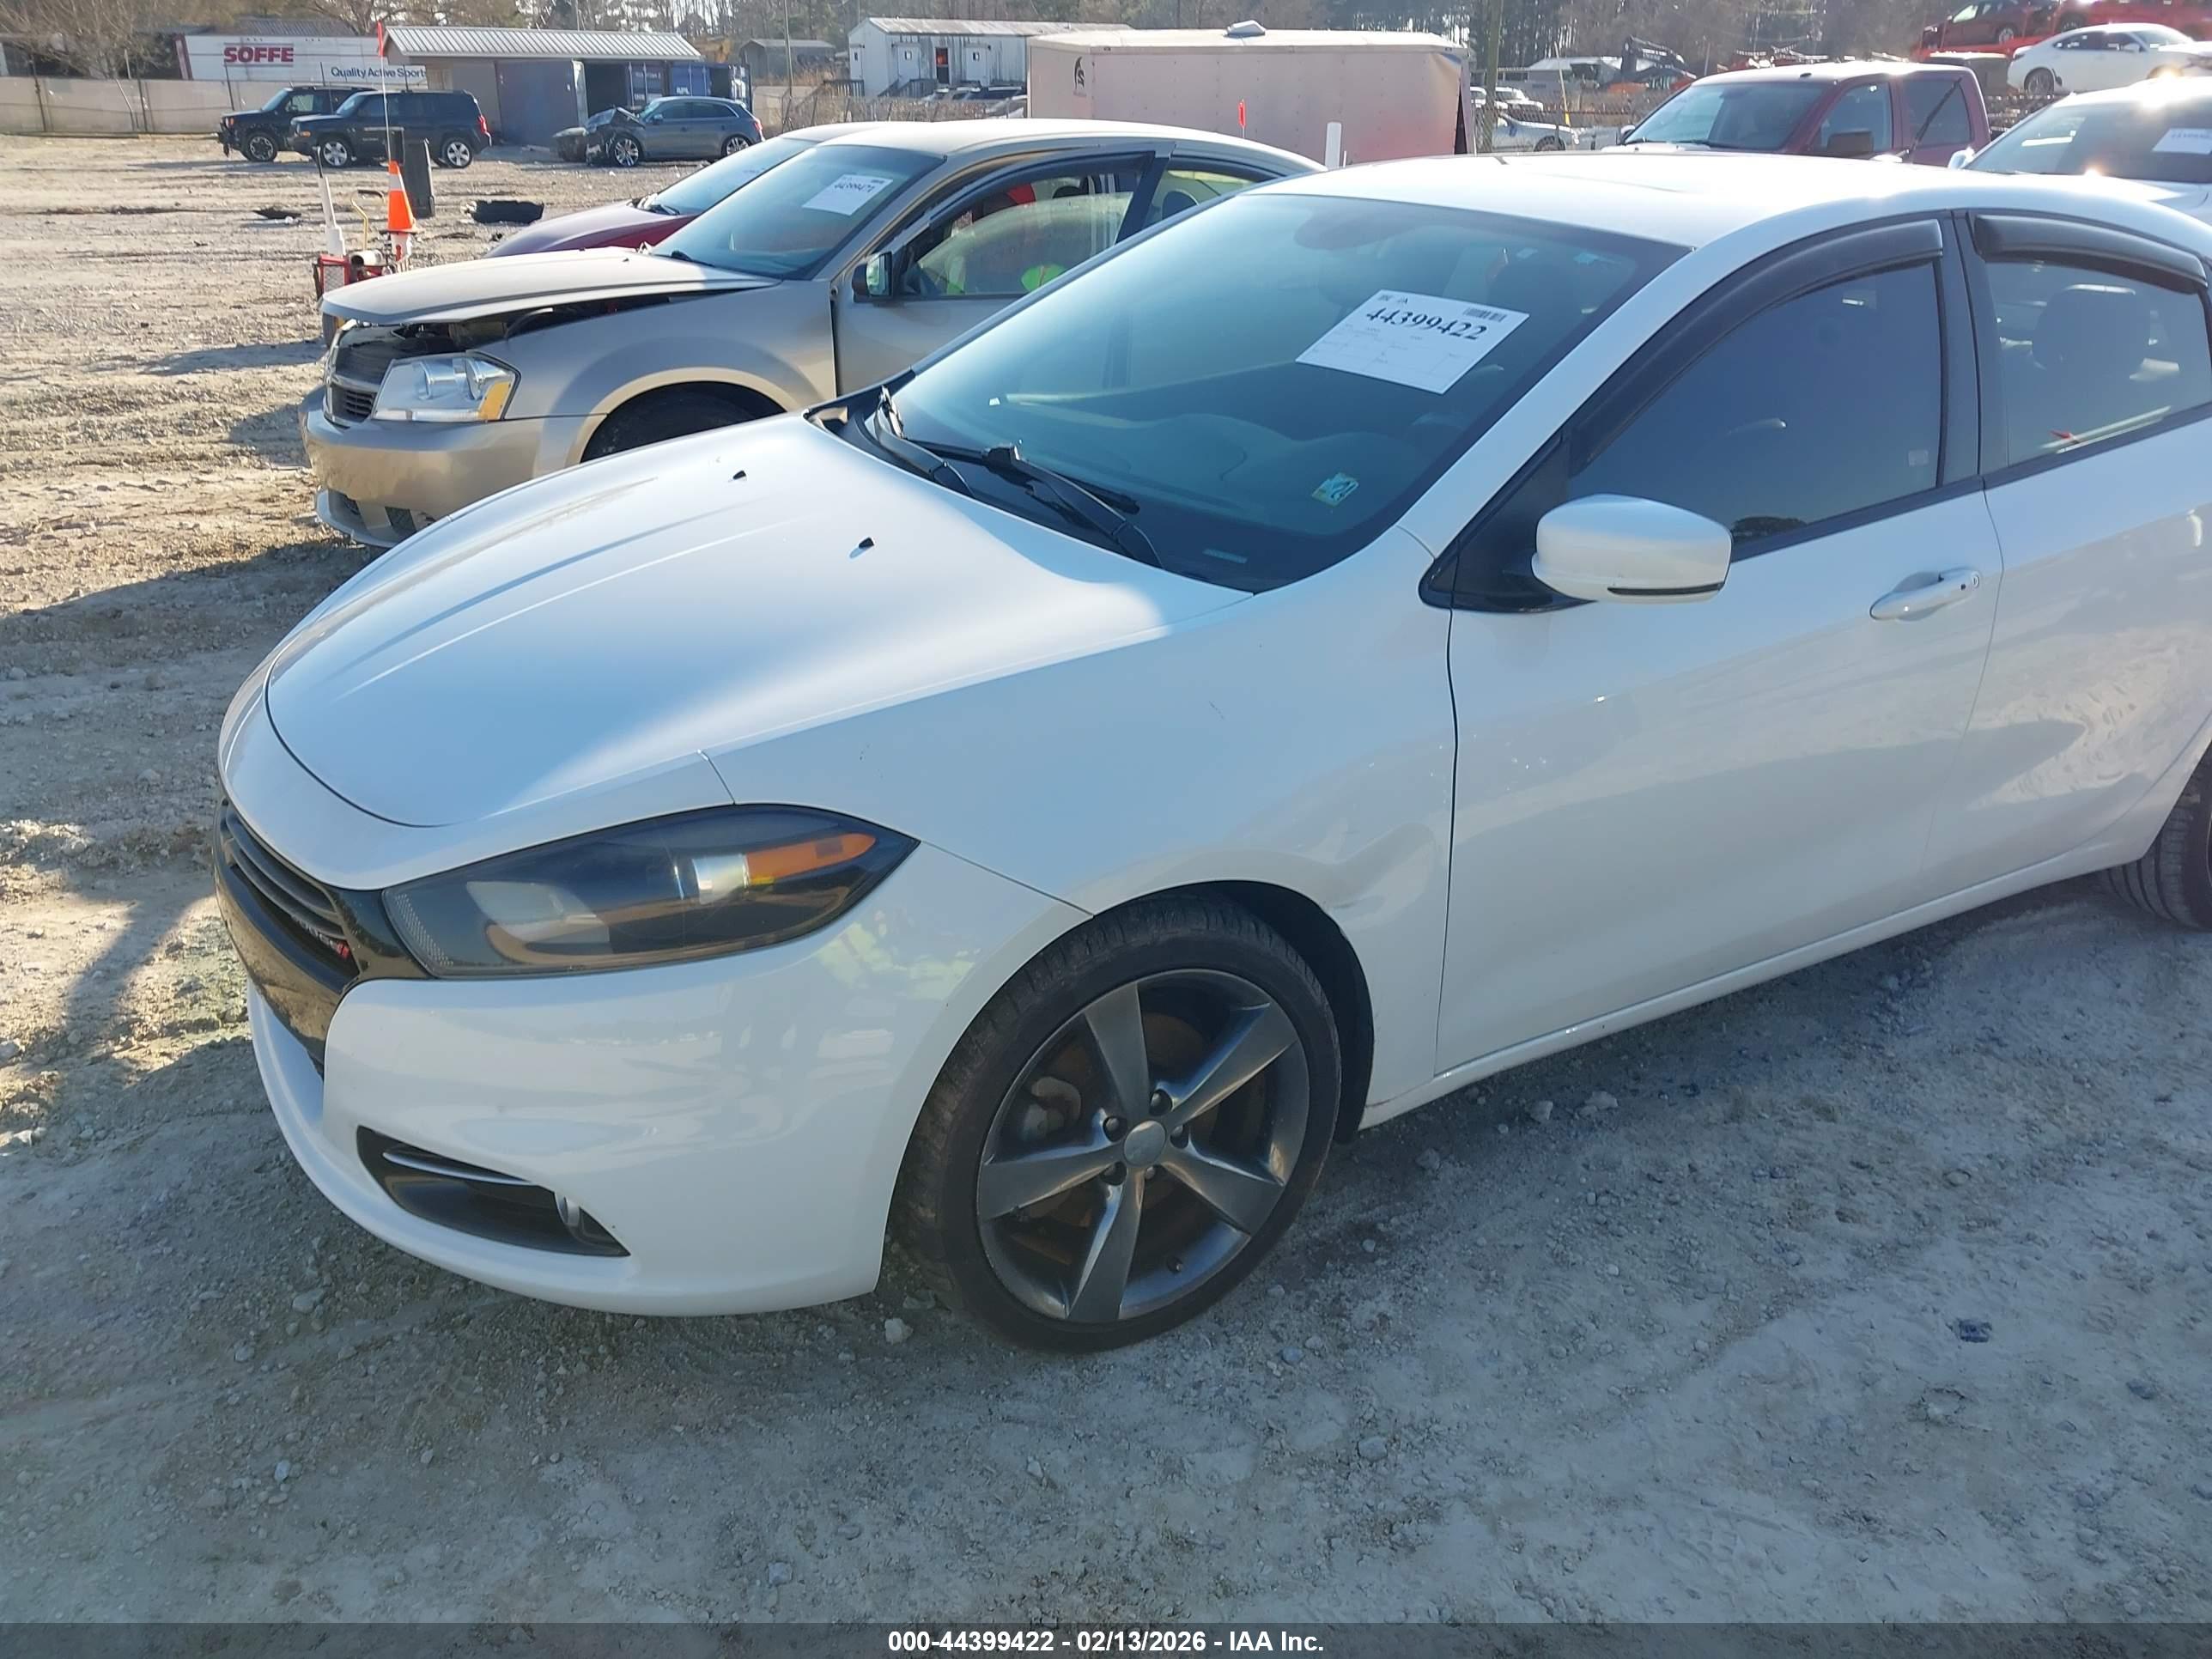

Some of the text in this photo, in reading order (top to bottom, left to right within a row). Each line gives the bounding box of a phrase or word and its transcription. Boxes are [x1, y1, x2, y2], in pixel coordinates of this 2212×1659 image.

[223, 47, 294, 63] SOFFE
[331, 67, 366, 79] Quality
[368, 68, 396, 77] Active
[1366, 307, 1487, 340] 44399422
